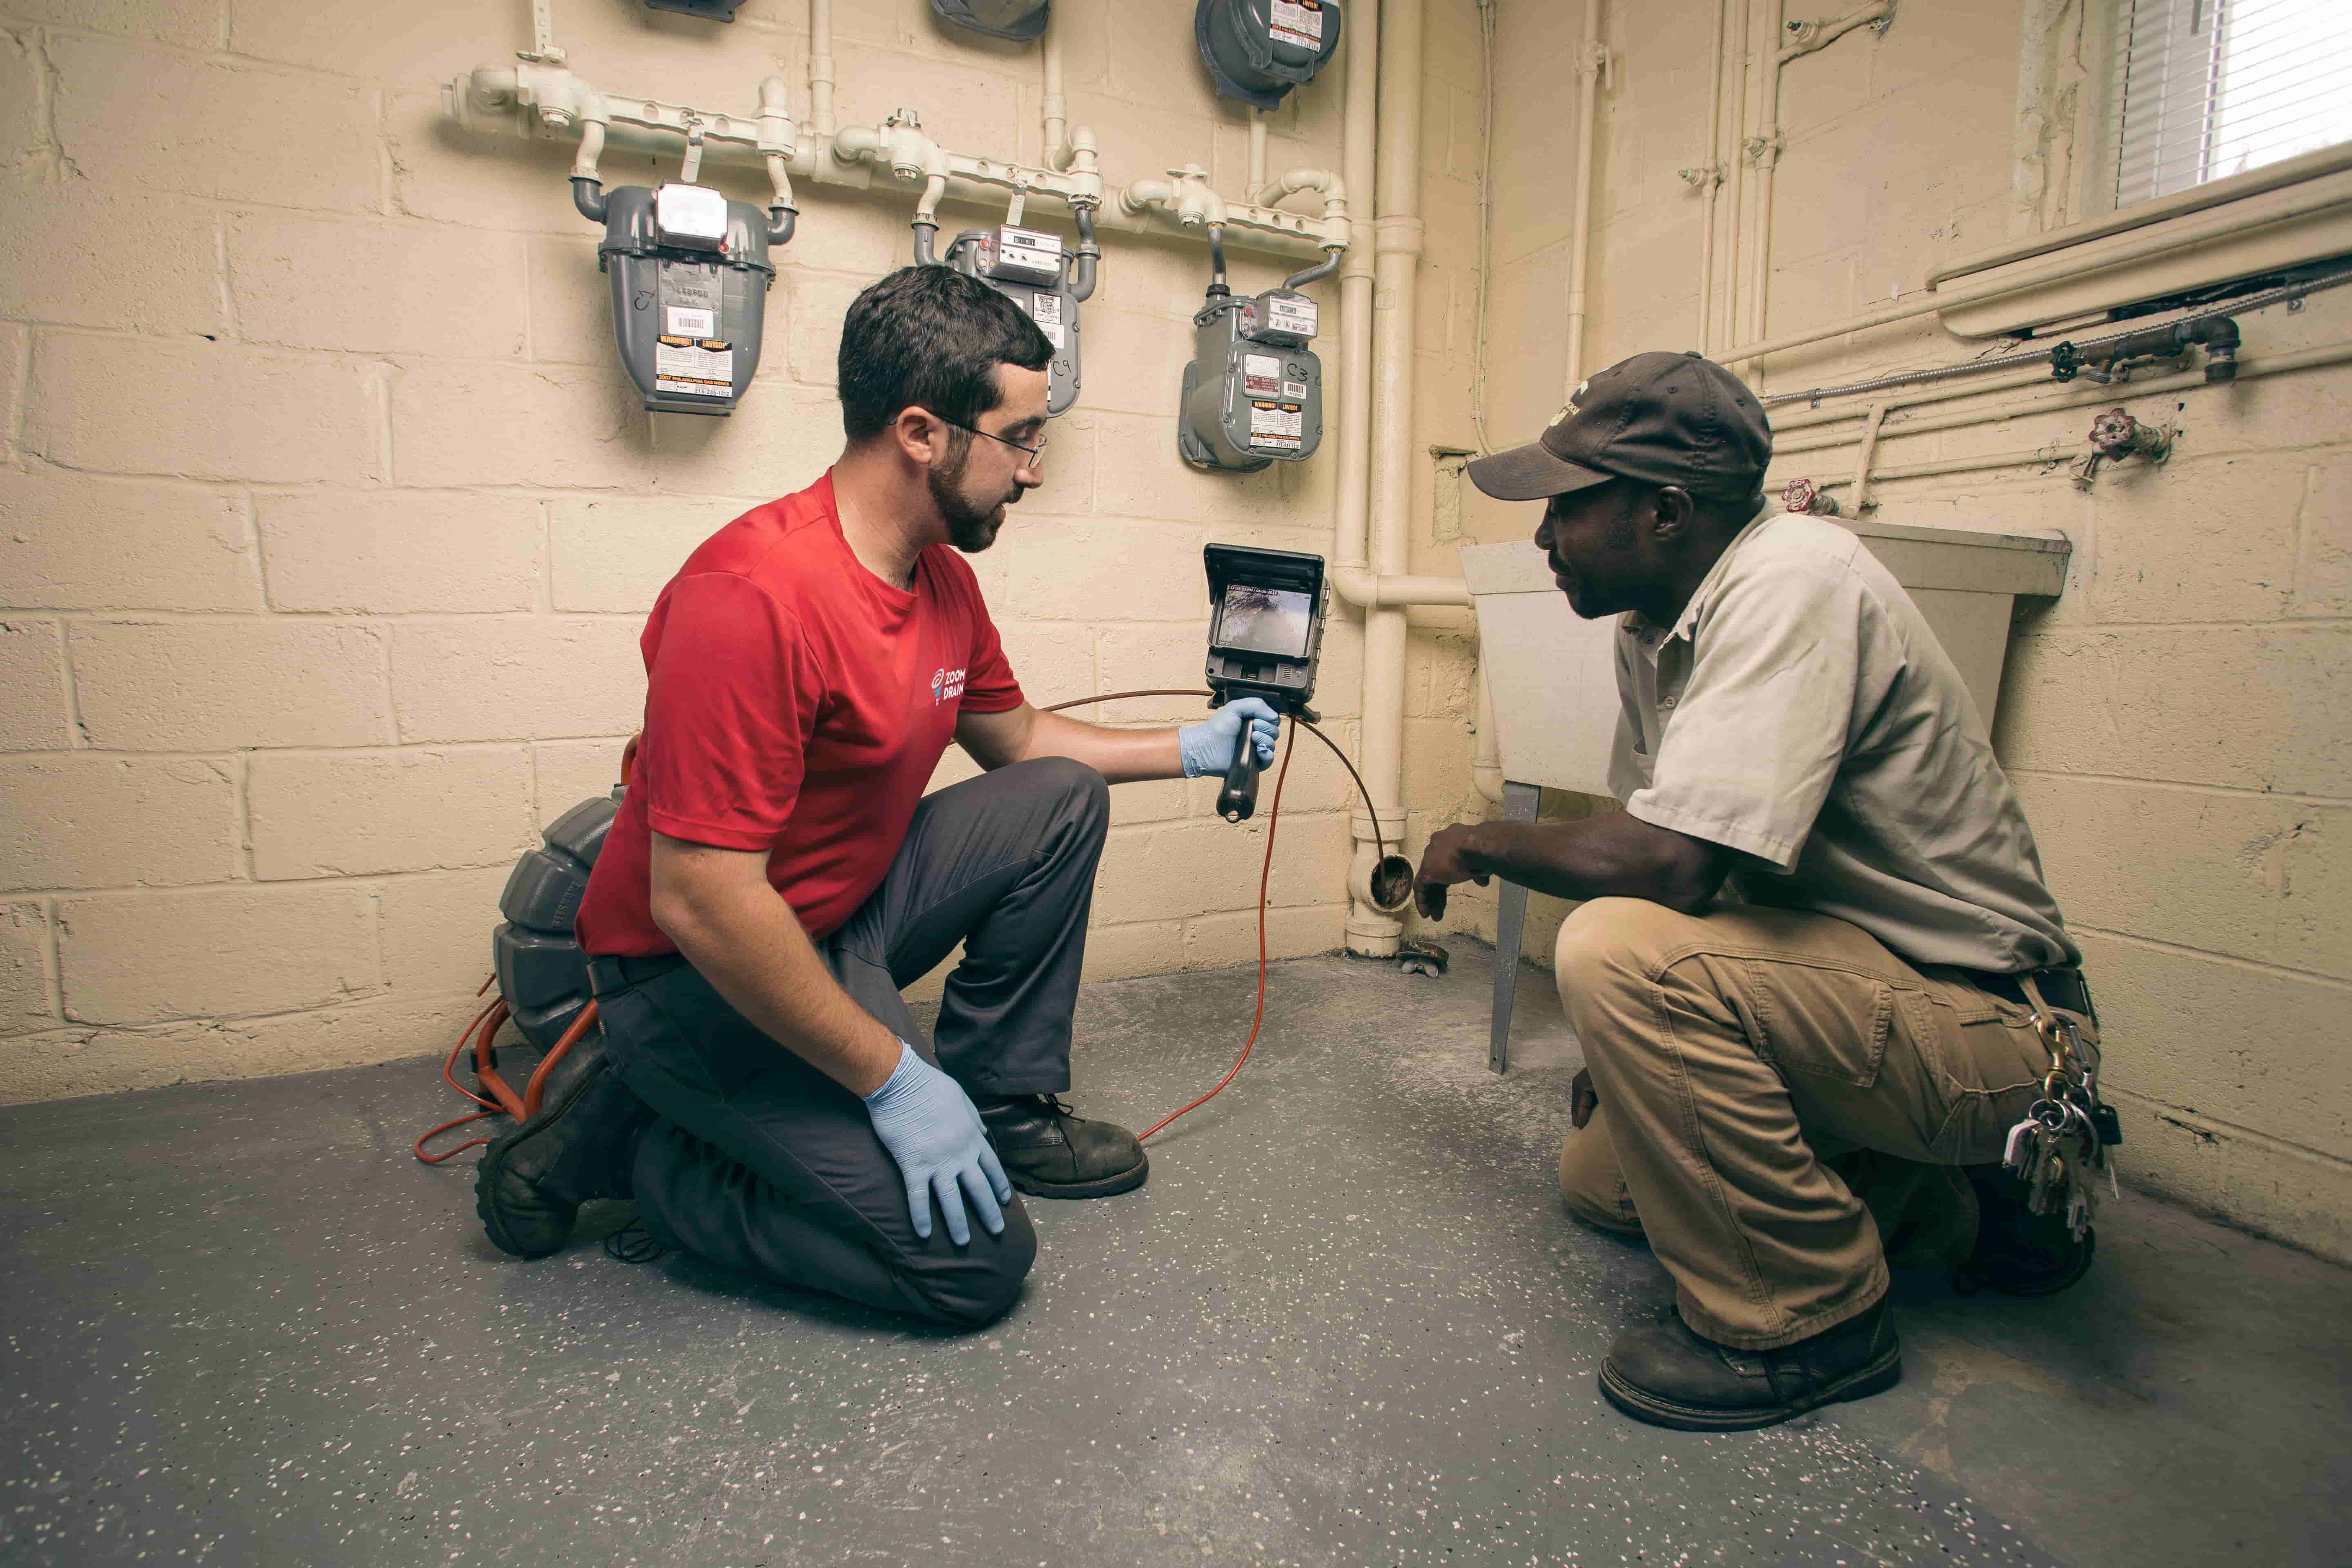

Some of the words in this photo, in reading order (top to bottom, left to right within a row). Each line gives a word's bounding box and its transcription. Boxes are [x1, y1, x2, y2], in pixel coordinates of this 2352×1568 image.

[659, 335, 692, 346] WARNING!
[1287, 363, 1308, 382] C3
[694, 388, 730, 396] 215-235-1212
[945, 668, 966, 686] ZOOM
[943, 682, 964, 700] DRAIN
